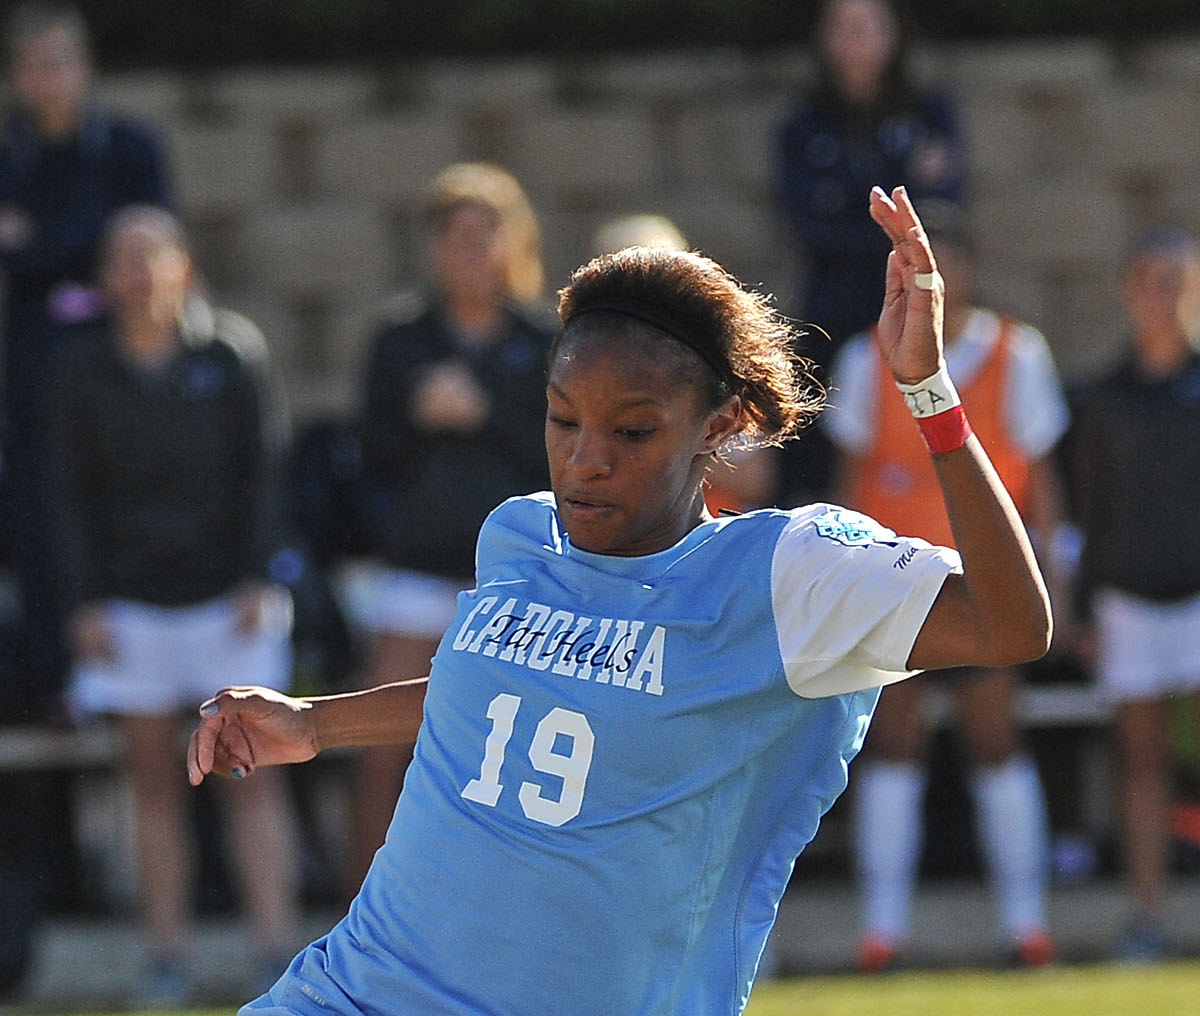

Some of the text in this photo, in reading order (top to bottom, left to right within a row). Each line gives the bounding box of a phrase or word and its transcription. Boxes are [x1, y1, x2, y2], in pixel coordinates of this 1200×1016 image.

[452, 597, 667, 696] CAROLINA
[486, 613, 638, 673] Tar Heels
[460, 693, 595, 827] 19
